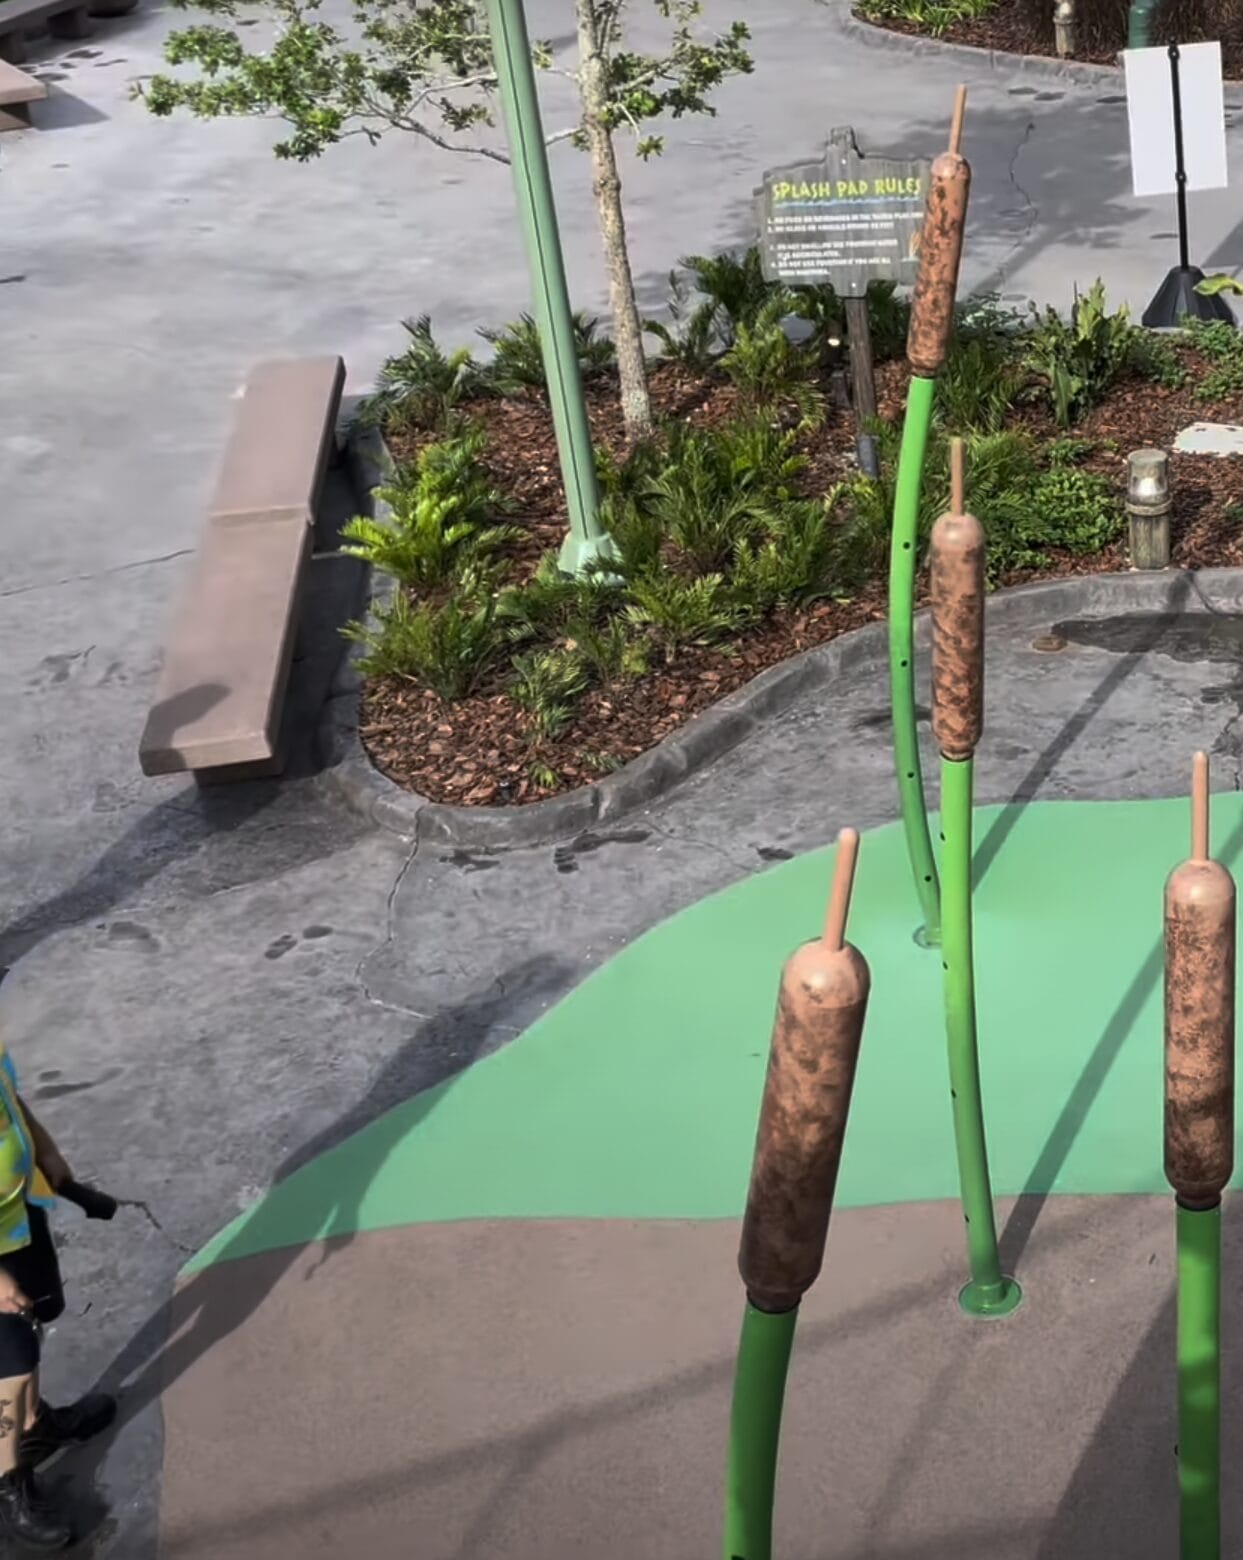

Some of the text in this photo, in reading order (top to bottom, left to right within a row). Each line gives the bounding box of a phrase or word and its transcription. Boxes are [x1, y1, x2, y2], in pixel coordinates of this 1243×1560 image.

[772, 177, 921, 200] SPLASH PAD RULES
